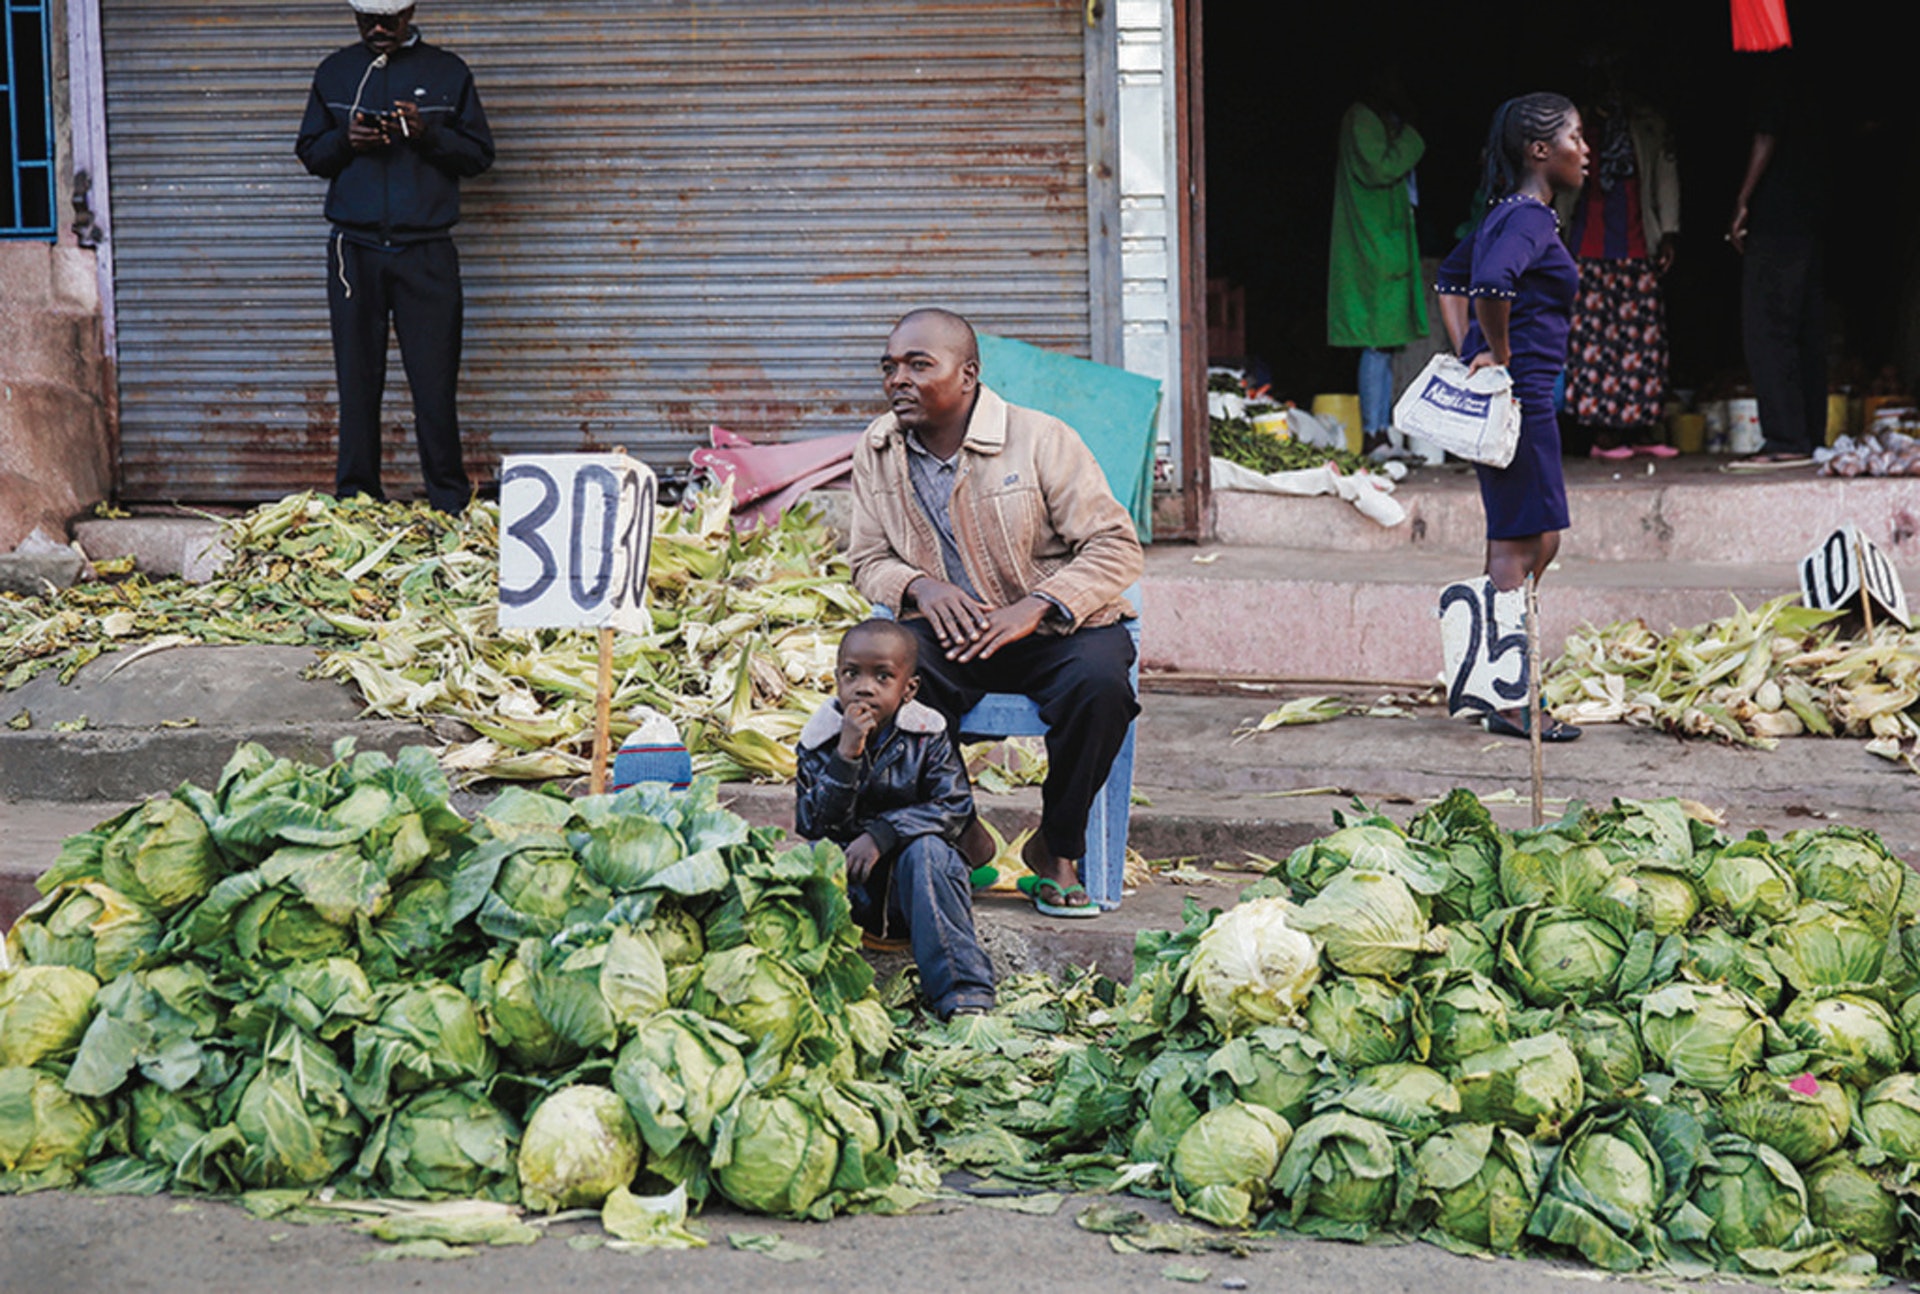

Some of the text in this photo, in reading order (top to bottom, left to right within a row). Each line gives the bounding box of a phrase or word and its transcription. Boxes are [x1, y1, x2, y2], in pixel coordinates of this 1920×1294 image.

[501, 464, 619, 610] 30
[611, 468, 654, 609] 30
[1805, 529, 1849, 609] 10
[1439, 581, 1531, 716] 25
